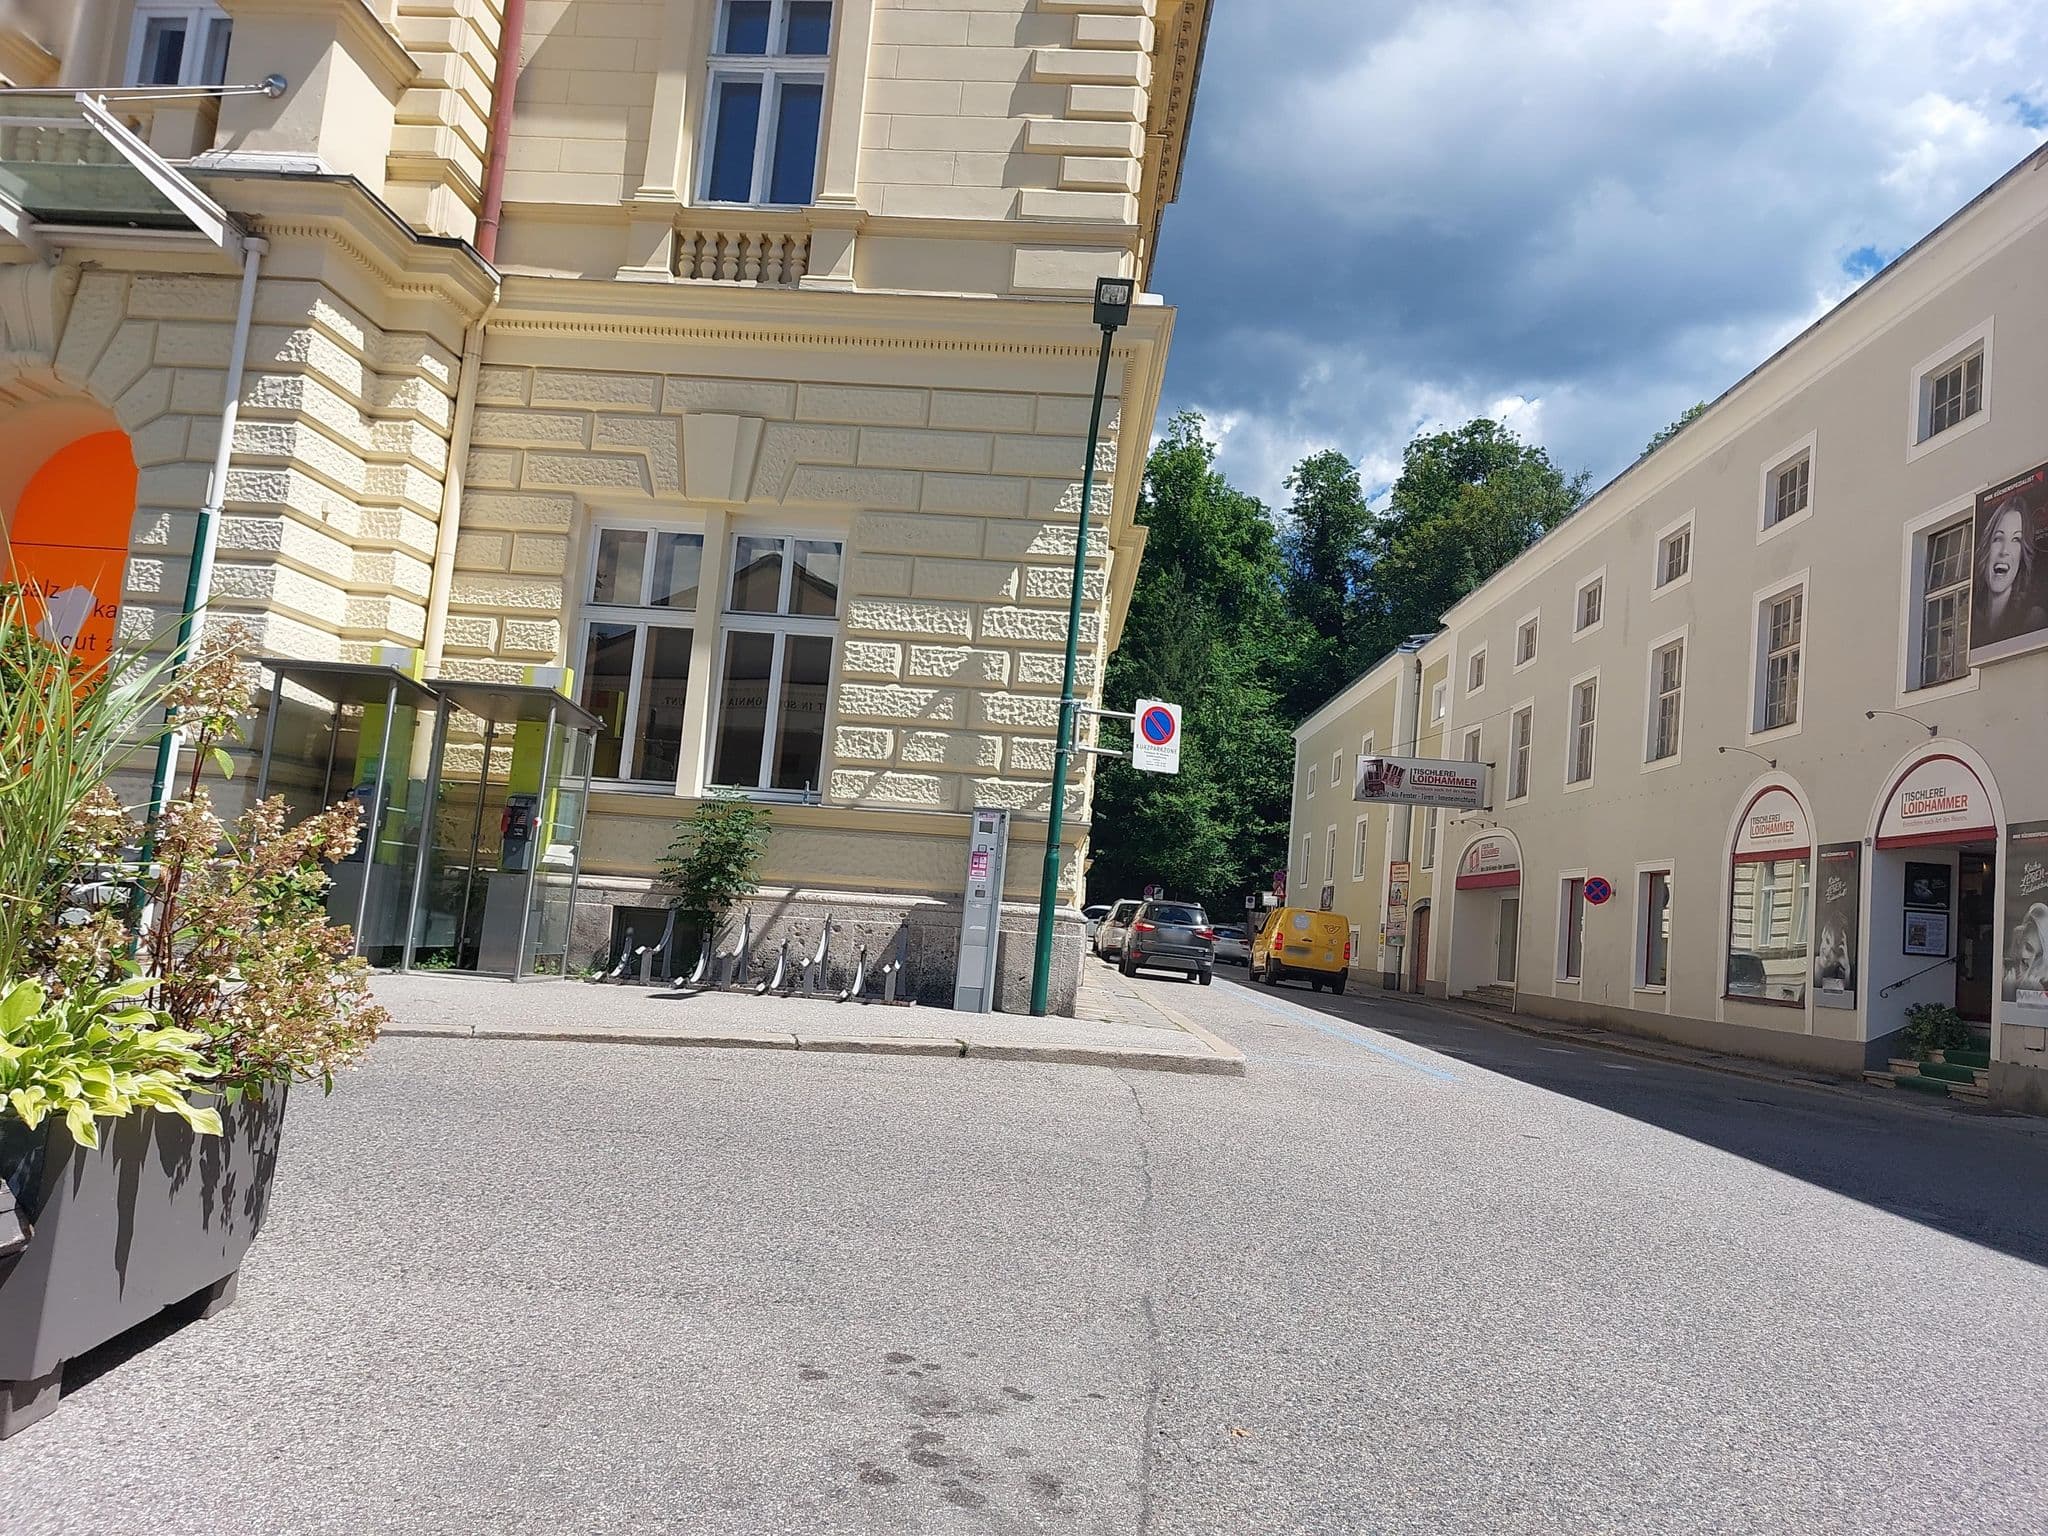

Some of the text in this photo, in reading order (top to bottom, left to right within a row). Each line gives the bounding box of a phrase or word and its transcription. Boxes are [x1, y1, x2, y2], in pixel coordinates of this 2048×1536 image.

[20, 579, 61, 599] salz
[1413, 768, 1457, 778] TISCHLEREI
[1412, 775, 1477, 787] LOIDHAMMER
[1904, 787, 1947, 802] TISCHLEREI
[1904, 794, 1968, 815] LOIDHAMMER
[1752, 820, 1795, 836] LOIDHAMMER
